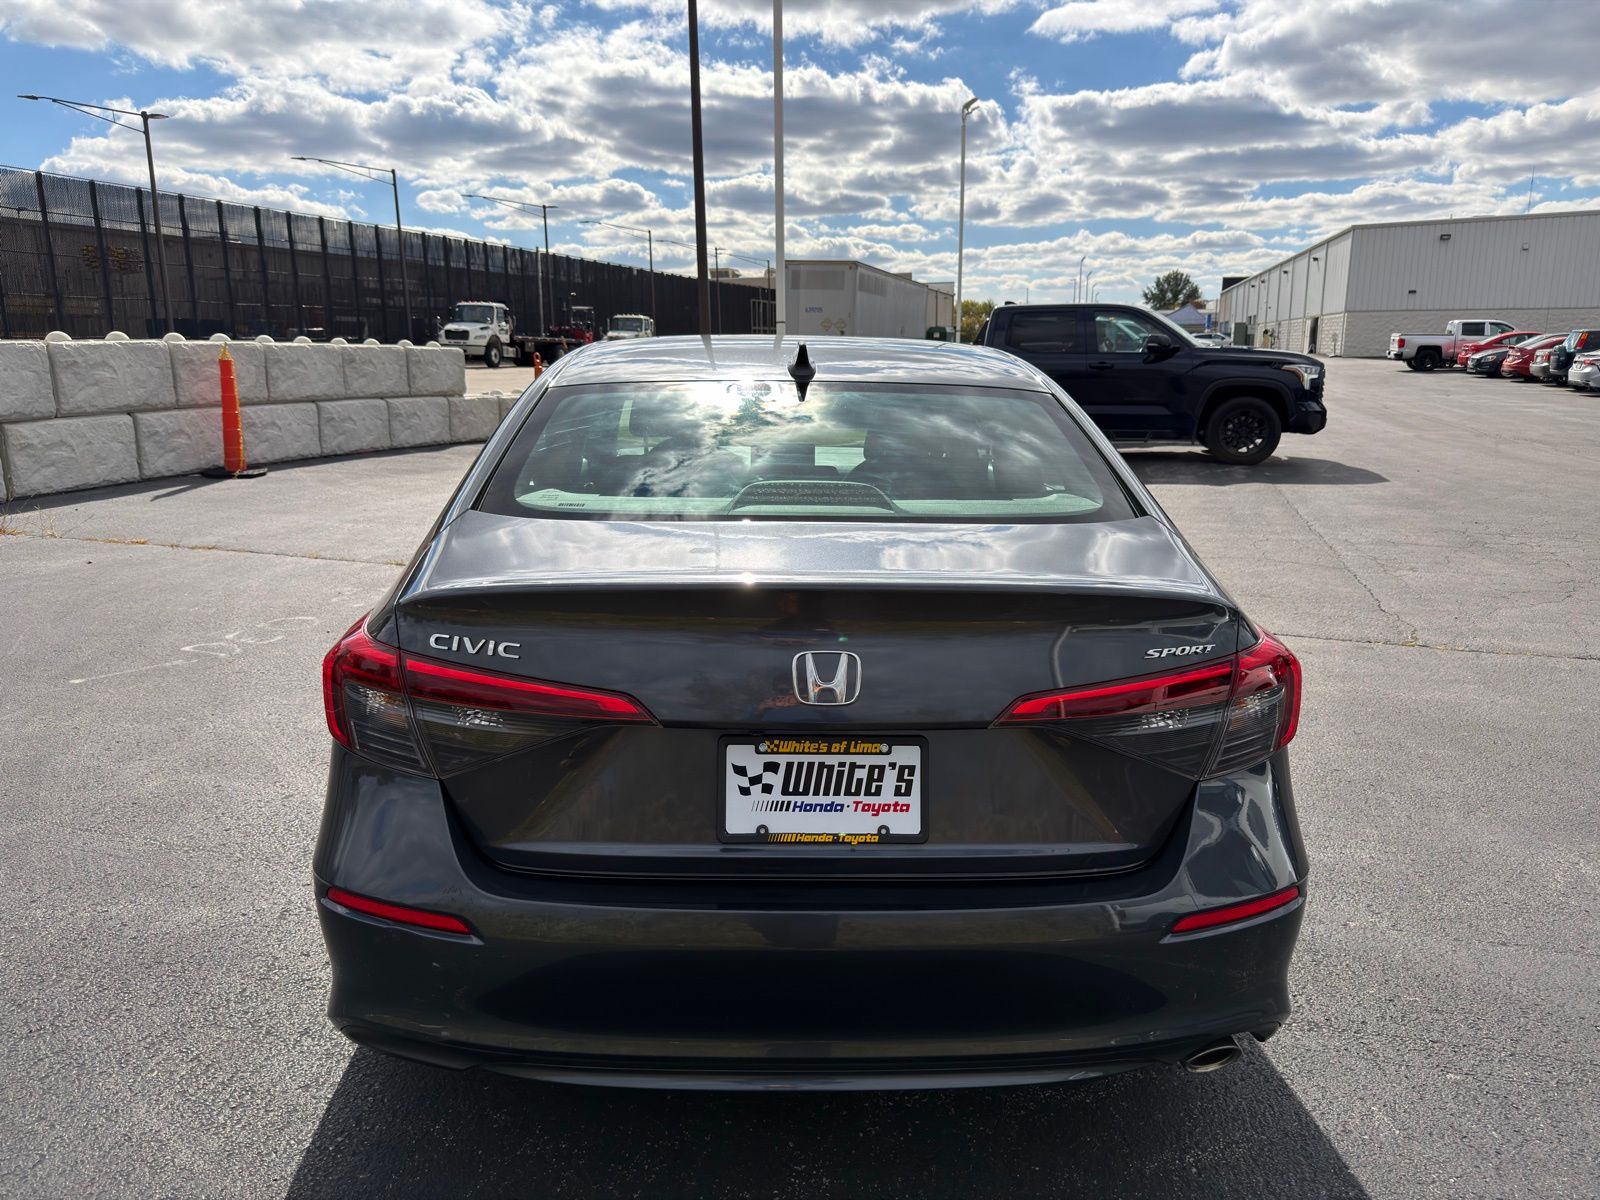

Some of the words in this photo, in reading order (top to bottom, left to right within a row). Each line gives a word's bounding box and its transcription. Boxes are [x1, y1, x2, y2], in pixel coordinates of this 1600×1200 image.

[429, 633, 521, 659] CIVIC
[1143, 644, 1216, 659] SPORT
[779, 741, 828, 753] White's
[831, 741, 847, 753] of
[850, 741, 880, 753] Lima
[781, 761, 917, 797] White's
[792, 801, 845, 813] Honda
[853, 801, 911, 816] Toyota
[797, 833, 833, 842] Honda
[839, 833, 879, 845] Toyota
